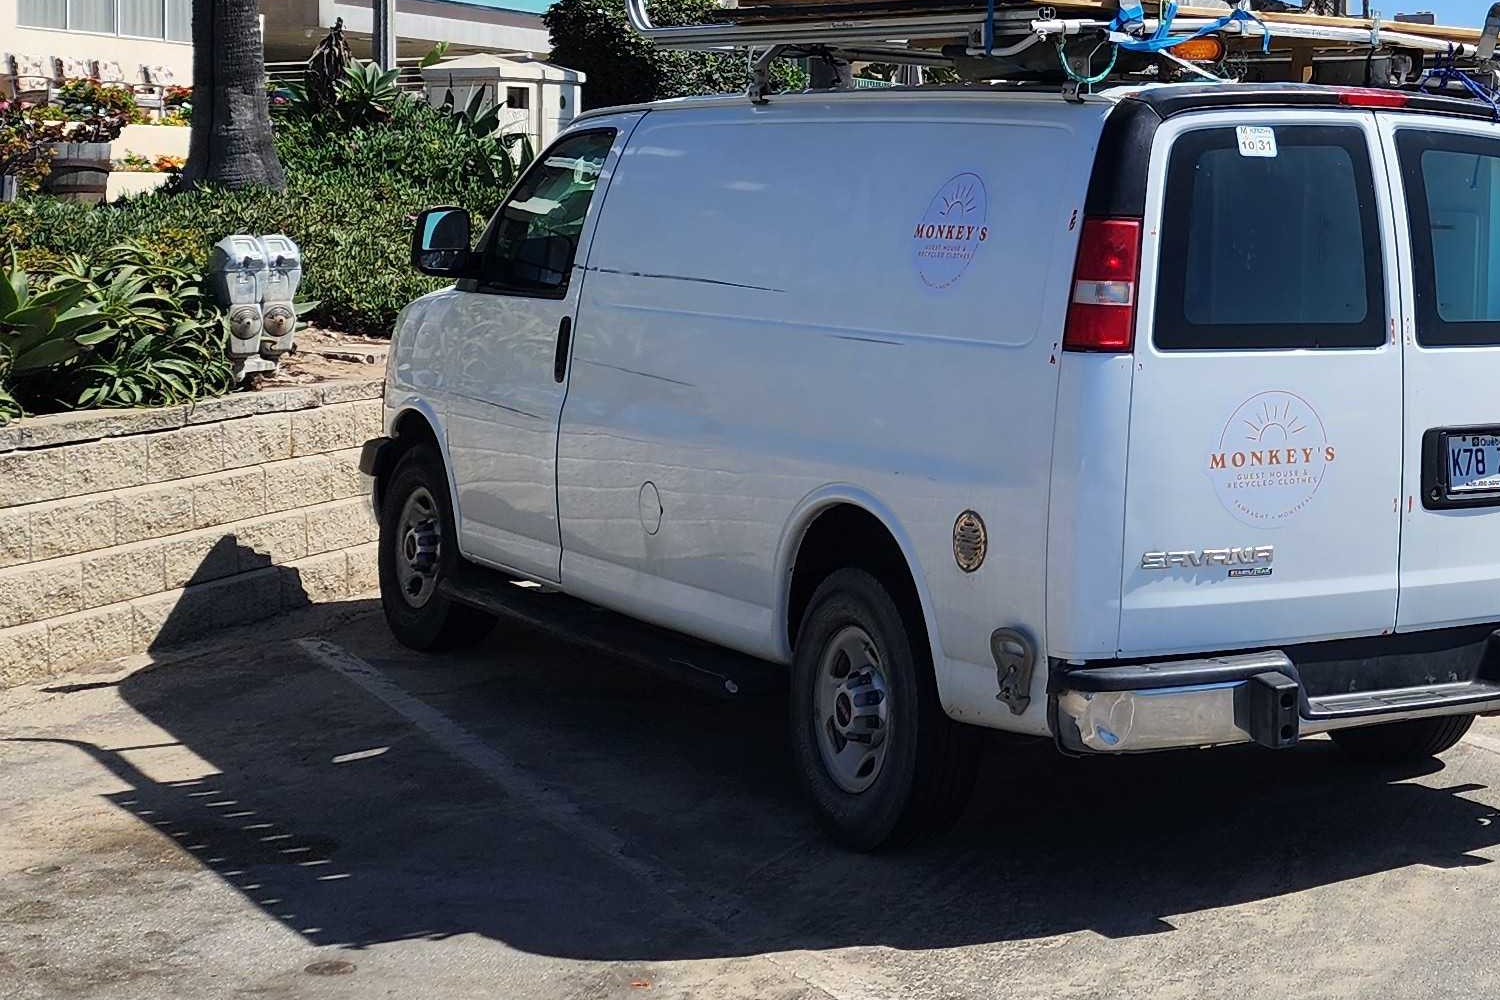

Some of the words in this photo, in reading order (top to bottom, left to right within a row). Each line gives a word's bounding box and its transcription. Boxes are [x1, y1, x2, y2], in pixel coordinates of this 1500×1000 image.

[914, 223, 988, 242] MONKEY'S
[1209, 446, 1335, 470] MONKEY'S
[1451, 447, 1486, 477] K78
[1227, 479, 1274, 489] RECYCLED
[1278, 476, 1318, 486] CLOTHES
[1236, 471, 1265, 481] GUEST
[1269, 469, 1298, 479] HOUSE
[1141, 545, 1274, 570] SAVANA
